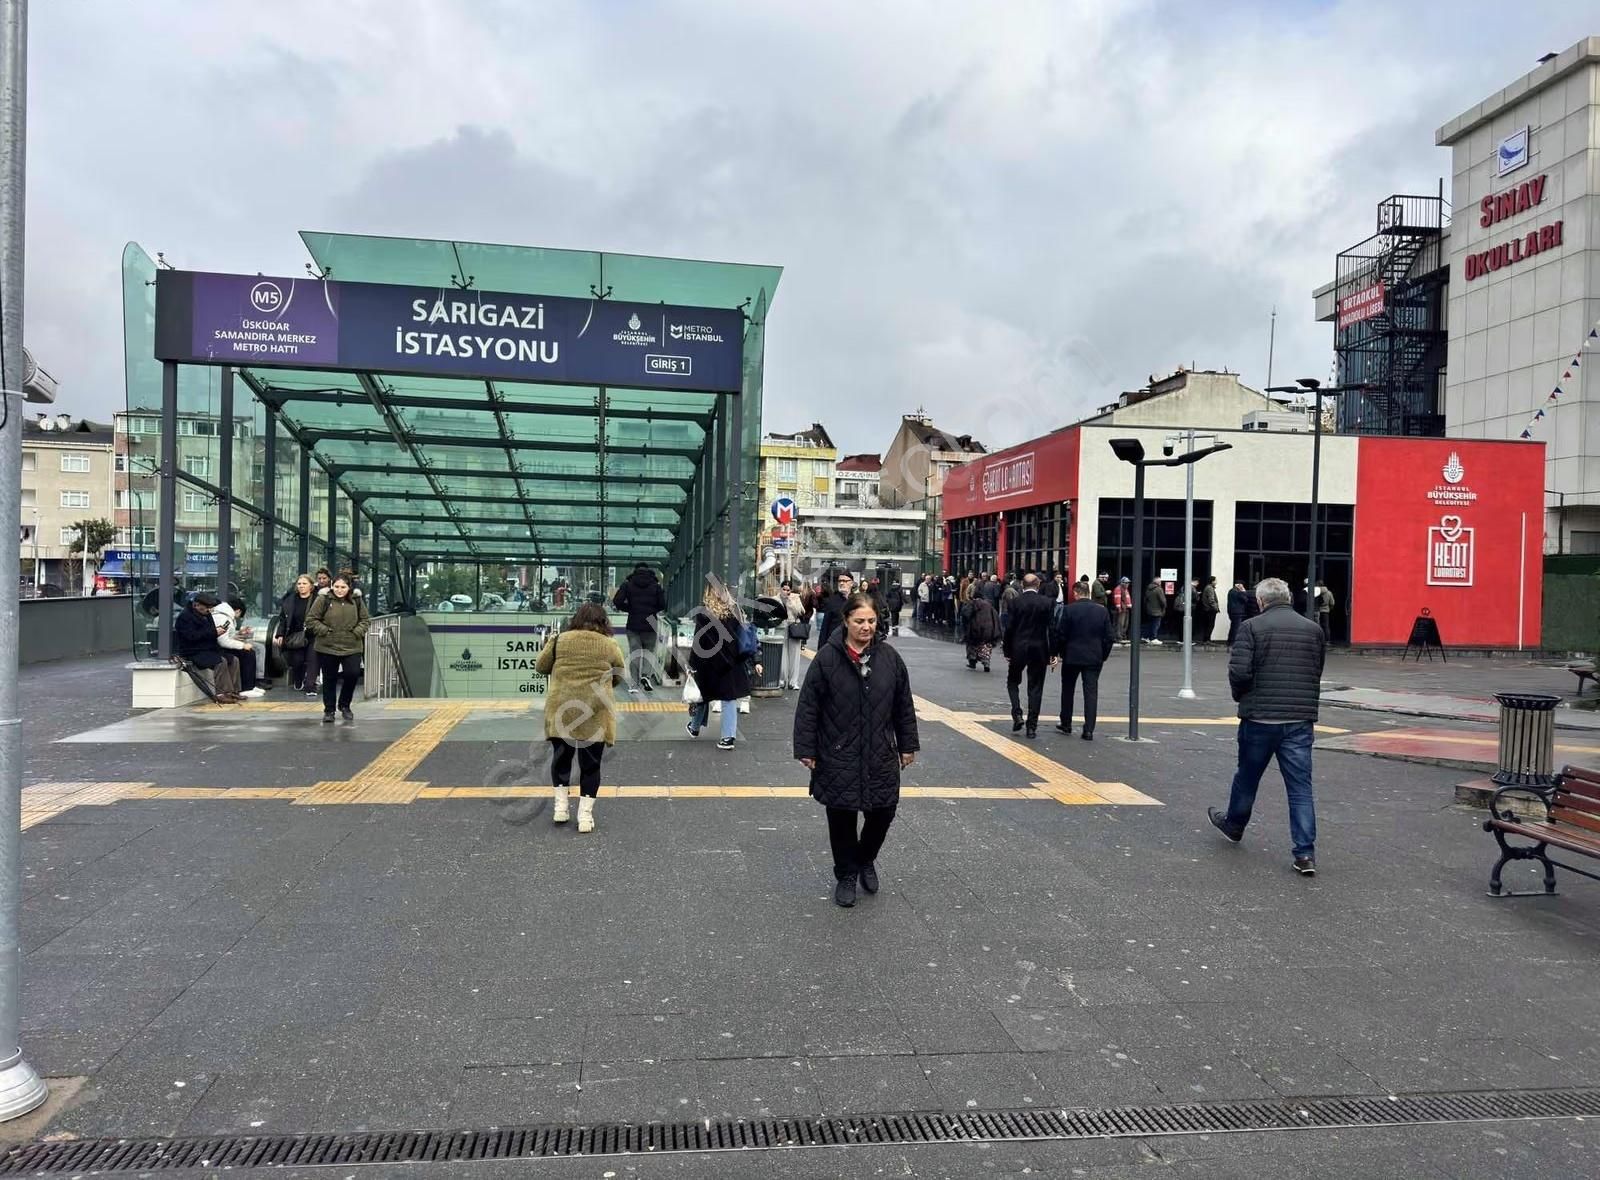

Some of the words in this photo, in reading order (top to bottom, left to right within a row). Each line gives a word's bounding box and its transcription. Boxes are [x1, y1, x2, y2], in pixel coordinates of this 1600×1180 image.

[1480, 174, 1548, 228] SINAV
[1464, 220, 1564, 281] OKULLARI
[254, 290, 279, 304] M5
[1343, 285, 1380, 311] ORTAOKUL
[412, 298, 544, 330] SARIGAZİ
[242, 319, 290, 331] ÜSKÜDAR
[684, 325, 713, 334] METRO
[214, 330, 275, 342] SAMANDIRA
[277, 334, 317, 344] MERKEZ
[683, 332, 724, 343] İSTANBUL
[233, 342, 268, 353] METRO
[270, 343, 298, 354] HATTI
[396, 326, 559, 364] İSTASYONU
[651, 359, 677, 372] GİRİŞ
[680, 361, 685, 370] 1
[506, 640, 543, 652] SARI
[519, 681, 545, 695] GİRİŞ
